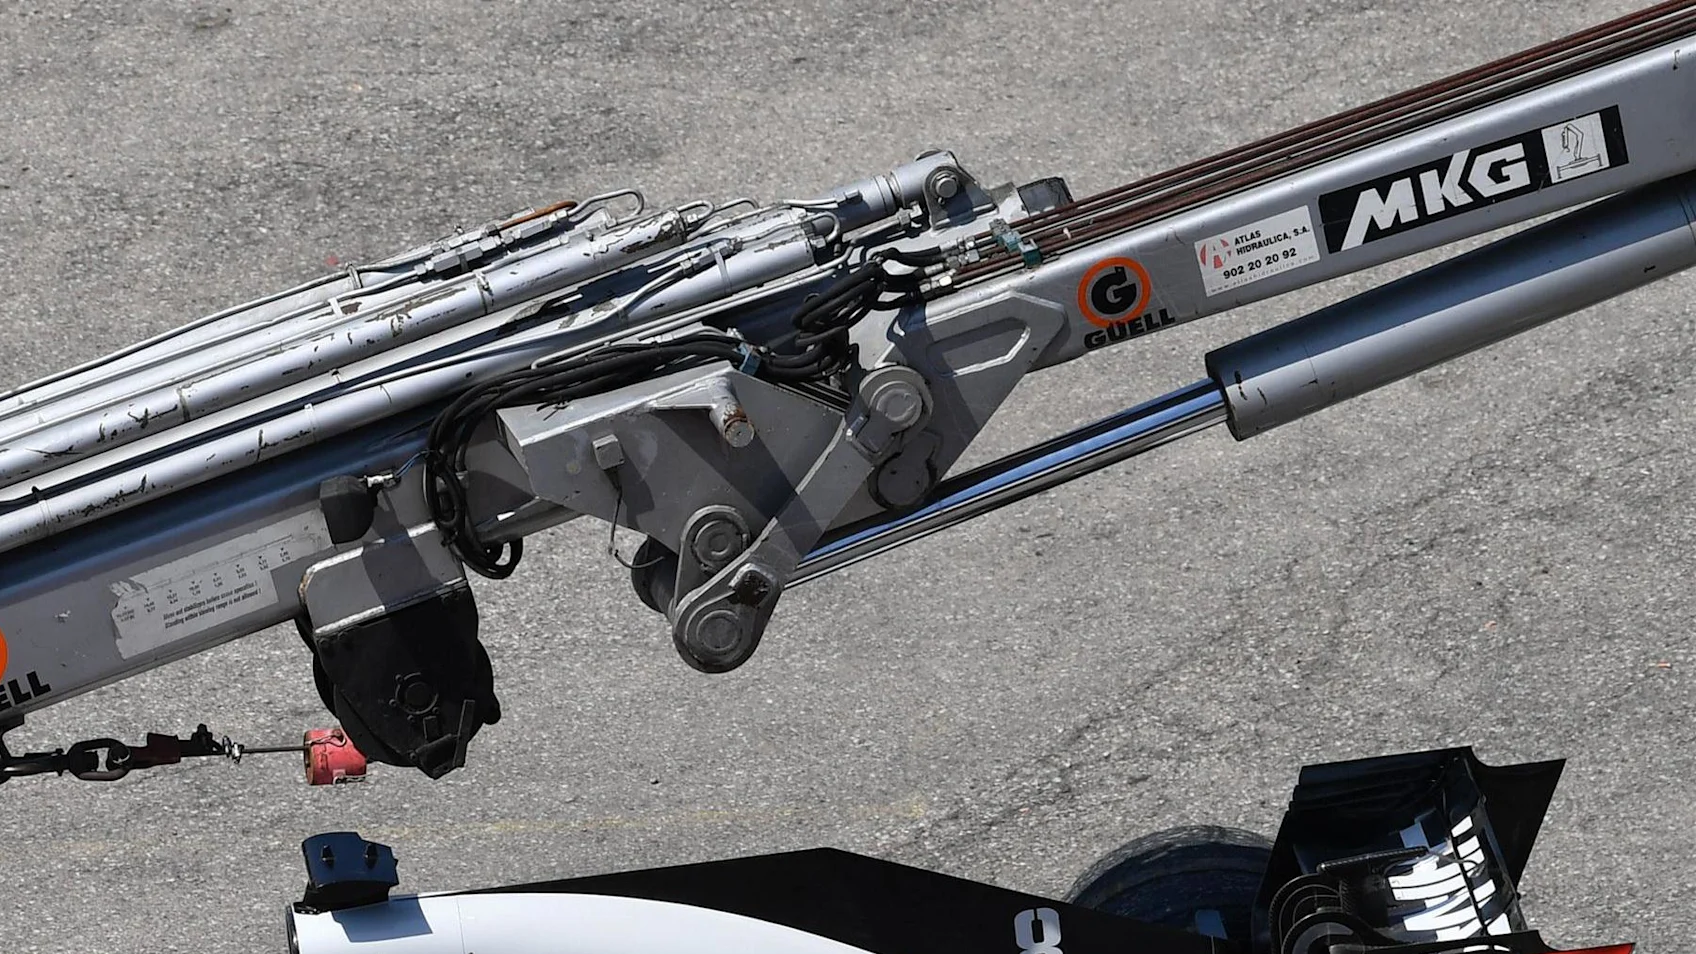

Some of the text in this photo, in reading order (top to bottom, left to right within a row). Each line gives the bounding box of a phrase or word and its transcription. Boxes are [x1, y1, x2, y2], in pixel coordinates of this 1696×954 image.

[1341, 142, 1530, 251] MKG
[1235, 231, 1261, 245] ATLAS
[1236, 225, 1310, 256] HIDRAULICA, S.A.
[1223, 248, 1297, 280] 902 20 20 92
[1084, 308, 1176, 349] GÜELL
